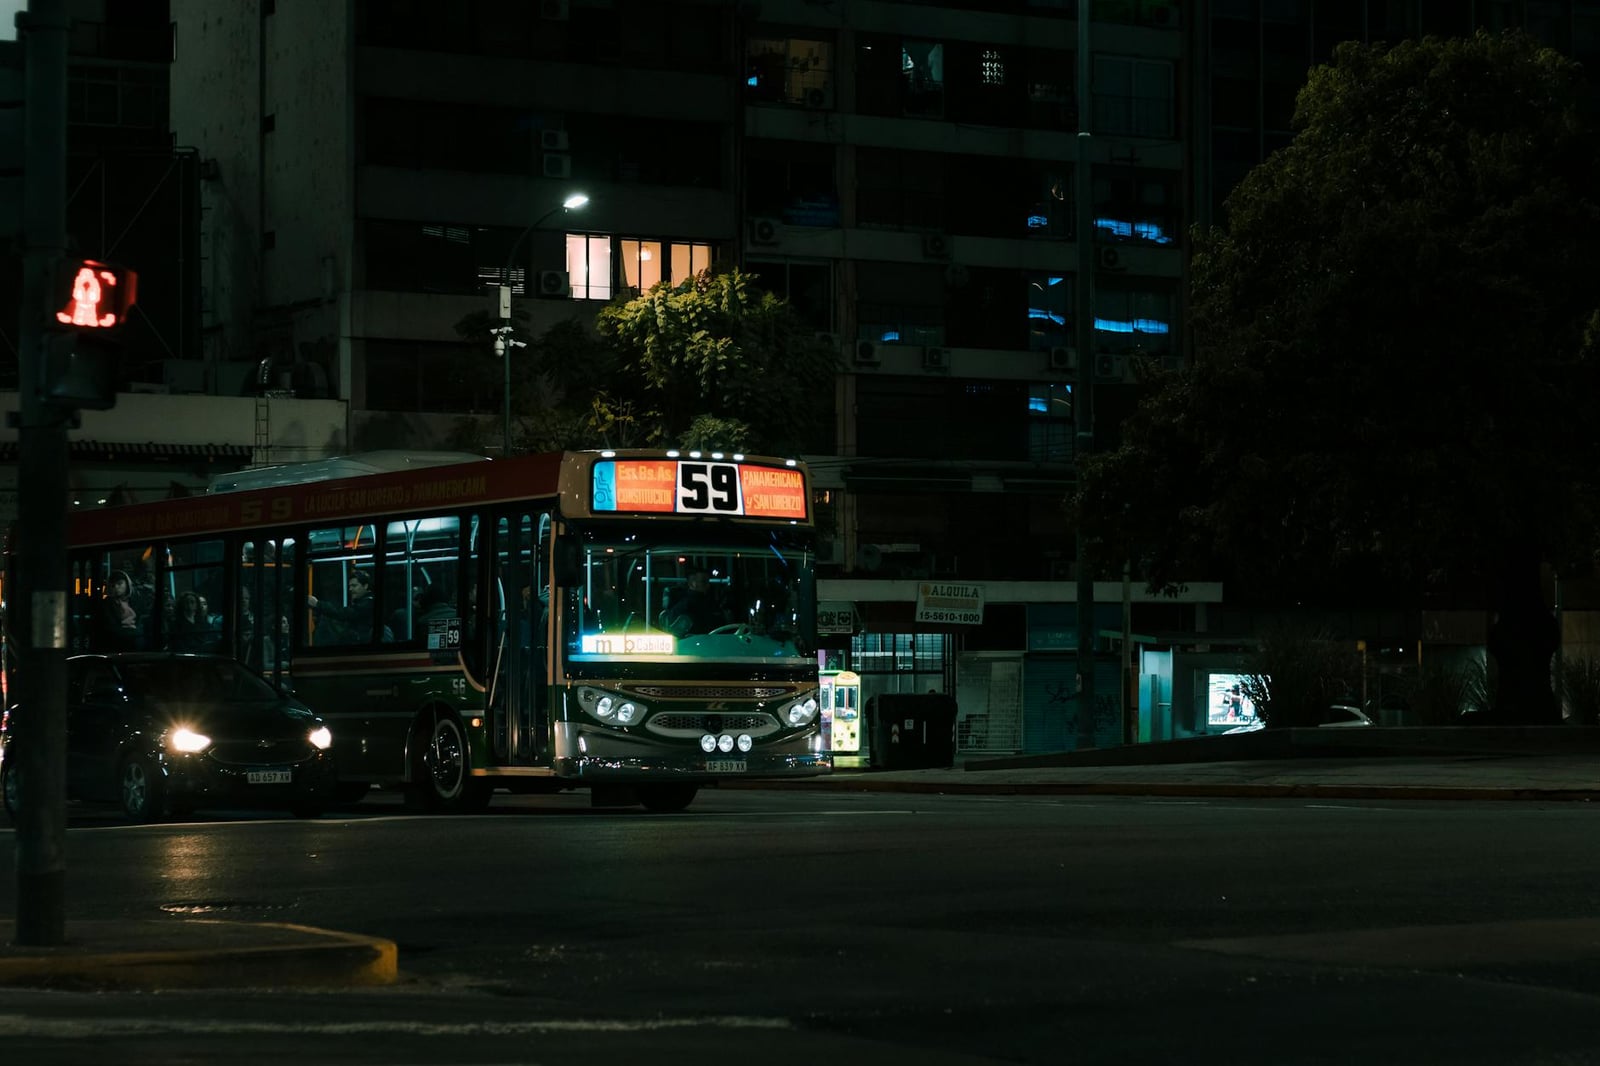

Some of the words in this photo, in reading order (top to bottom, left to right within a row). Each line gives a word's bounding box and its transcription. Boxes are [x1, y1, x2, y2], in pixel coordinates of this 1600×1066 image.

[681, 463, 738, 511] 59
[743, 470, 802, 489] PANAMERICANA
[239, 496, 293, 523] 59
[753, 494, 769, 510] SAN
[769, 495, 801, 511] LORENZO
[931, 585, 980, 598] ALQUILA
[448, 629, 460, 644] 59
[262, 773, 277, 782] 657
